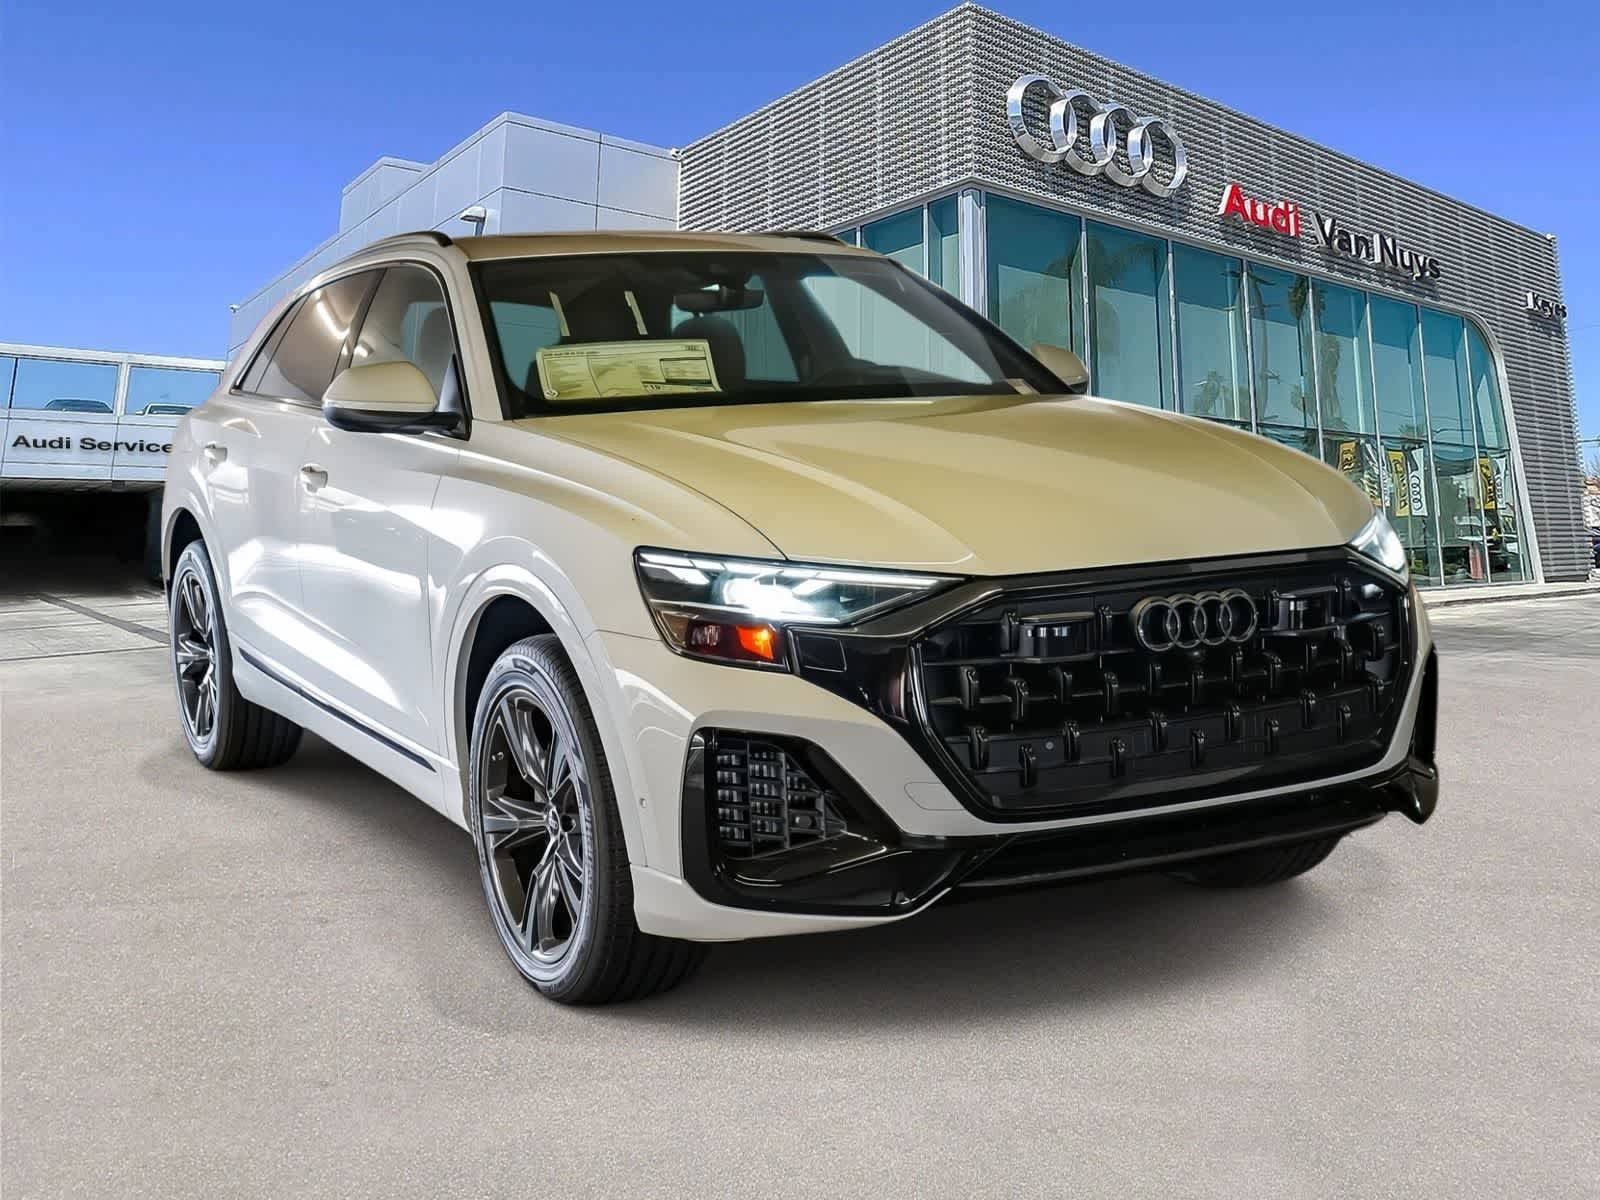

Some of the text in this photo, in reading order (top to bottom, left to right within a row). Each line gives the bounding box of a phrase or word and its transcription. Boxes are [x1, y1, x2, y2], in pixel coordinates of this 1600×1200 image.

[1217, 182, 1441, 280] Audi Van Nuys
[12, 434, 174, 454] Audi Service
